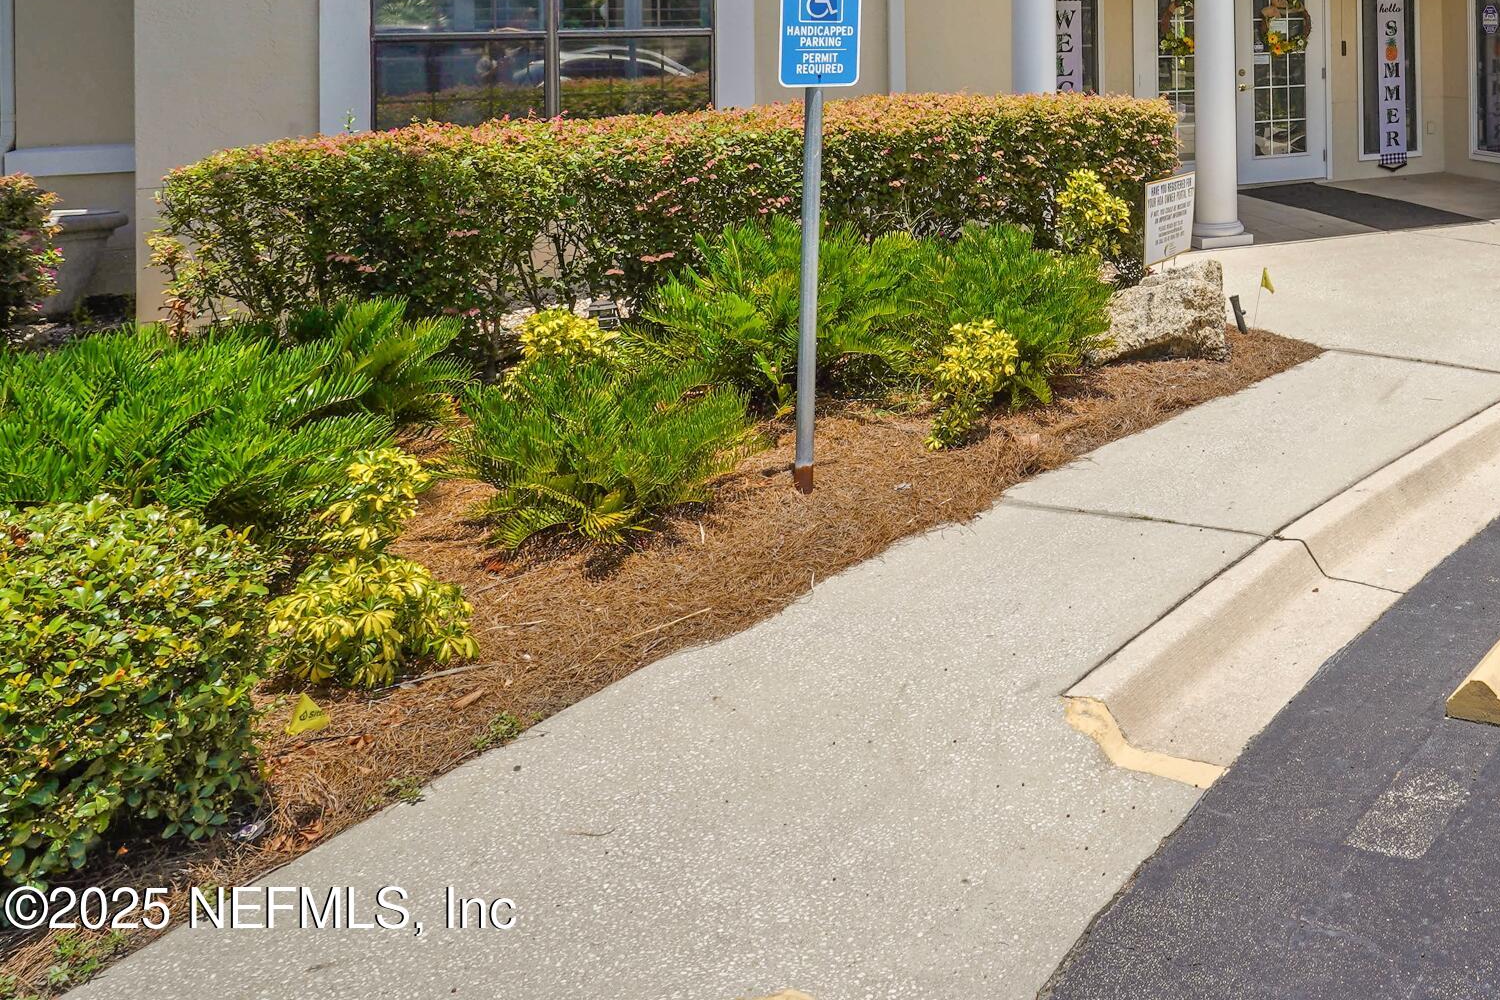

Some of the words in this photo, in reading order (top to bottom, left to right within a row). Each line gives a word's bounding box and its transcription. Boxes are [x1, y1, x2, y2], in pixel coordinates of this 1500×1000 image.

[1379, 3, 1402, 13] hello
[787, 26, 854, 36] HANDICAPPED
[800, 37, 842, 47] PARKING
[802, 53, 839, 63] PERMIT
[796, 64, 844, 75] REQUIRED
[1383, 20, 1401, 147] SMMER
[1151, 185, 1160, 196] HAVE
[1168, 179, 1185, 192] REGISTERED
[1148, 198, 1156, 208] YOUR
